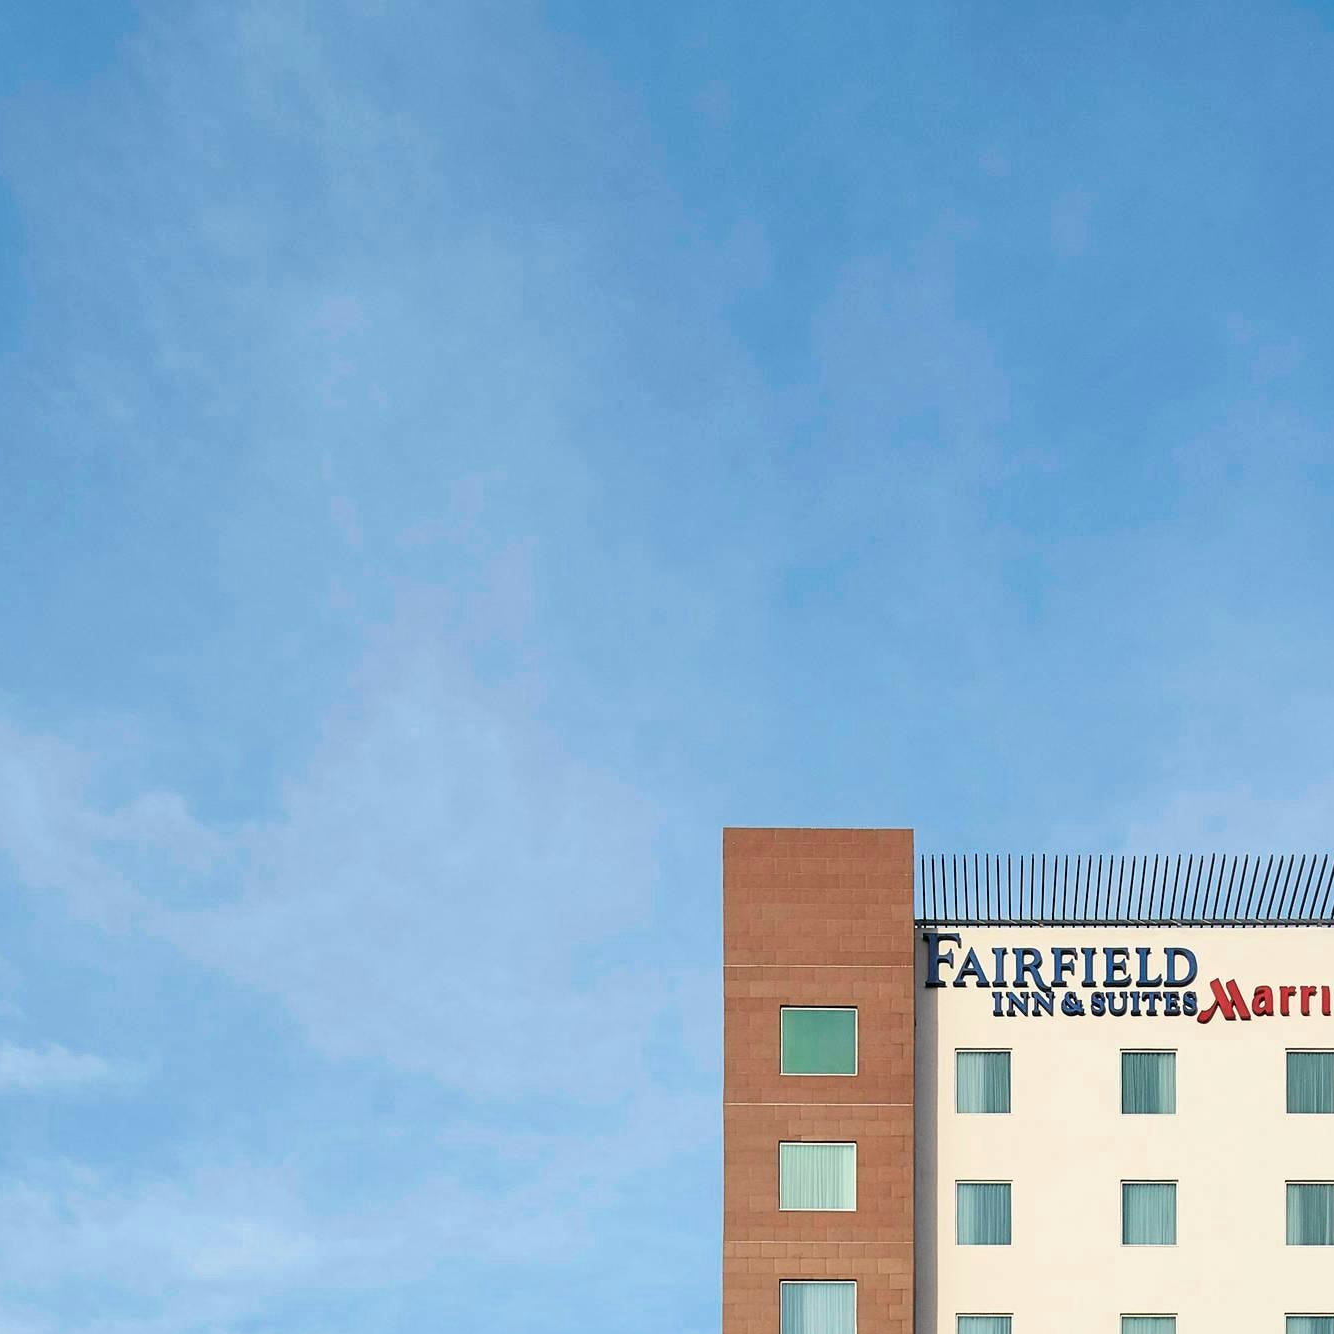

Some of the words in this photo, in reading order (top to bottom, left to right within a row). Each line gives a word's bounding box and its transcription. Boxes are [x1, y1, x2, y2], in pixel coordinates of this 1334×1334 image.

[923, 932, 1198, 992] FAIRFIELD
[993, 991, 1055, 1017] INN
[1061, 991, 1086, 1017] &
[1091, 991, 1199, 1017] SUITES
